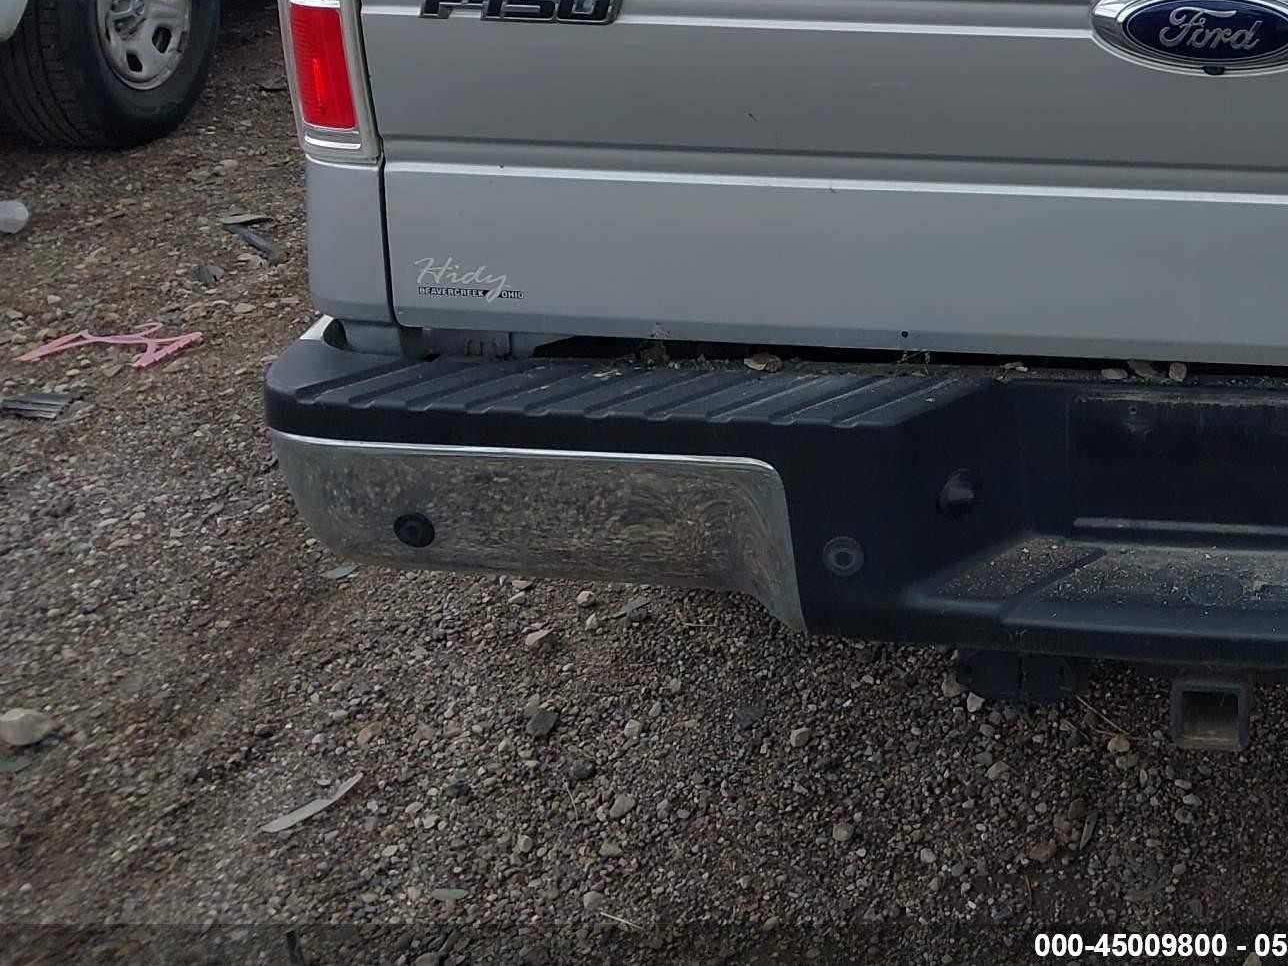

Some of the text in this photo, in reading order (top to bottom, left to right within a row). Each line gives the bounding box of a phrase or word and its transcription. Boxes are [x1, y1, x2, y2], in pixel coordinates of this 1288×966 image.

[1159, 5, 1264, 50] Ford
[413, 256, 512, 303] Hidy
[418, 286, 525, 299] BEAVERCREEK OHIO
